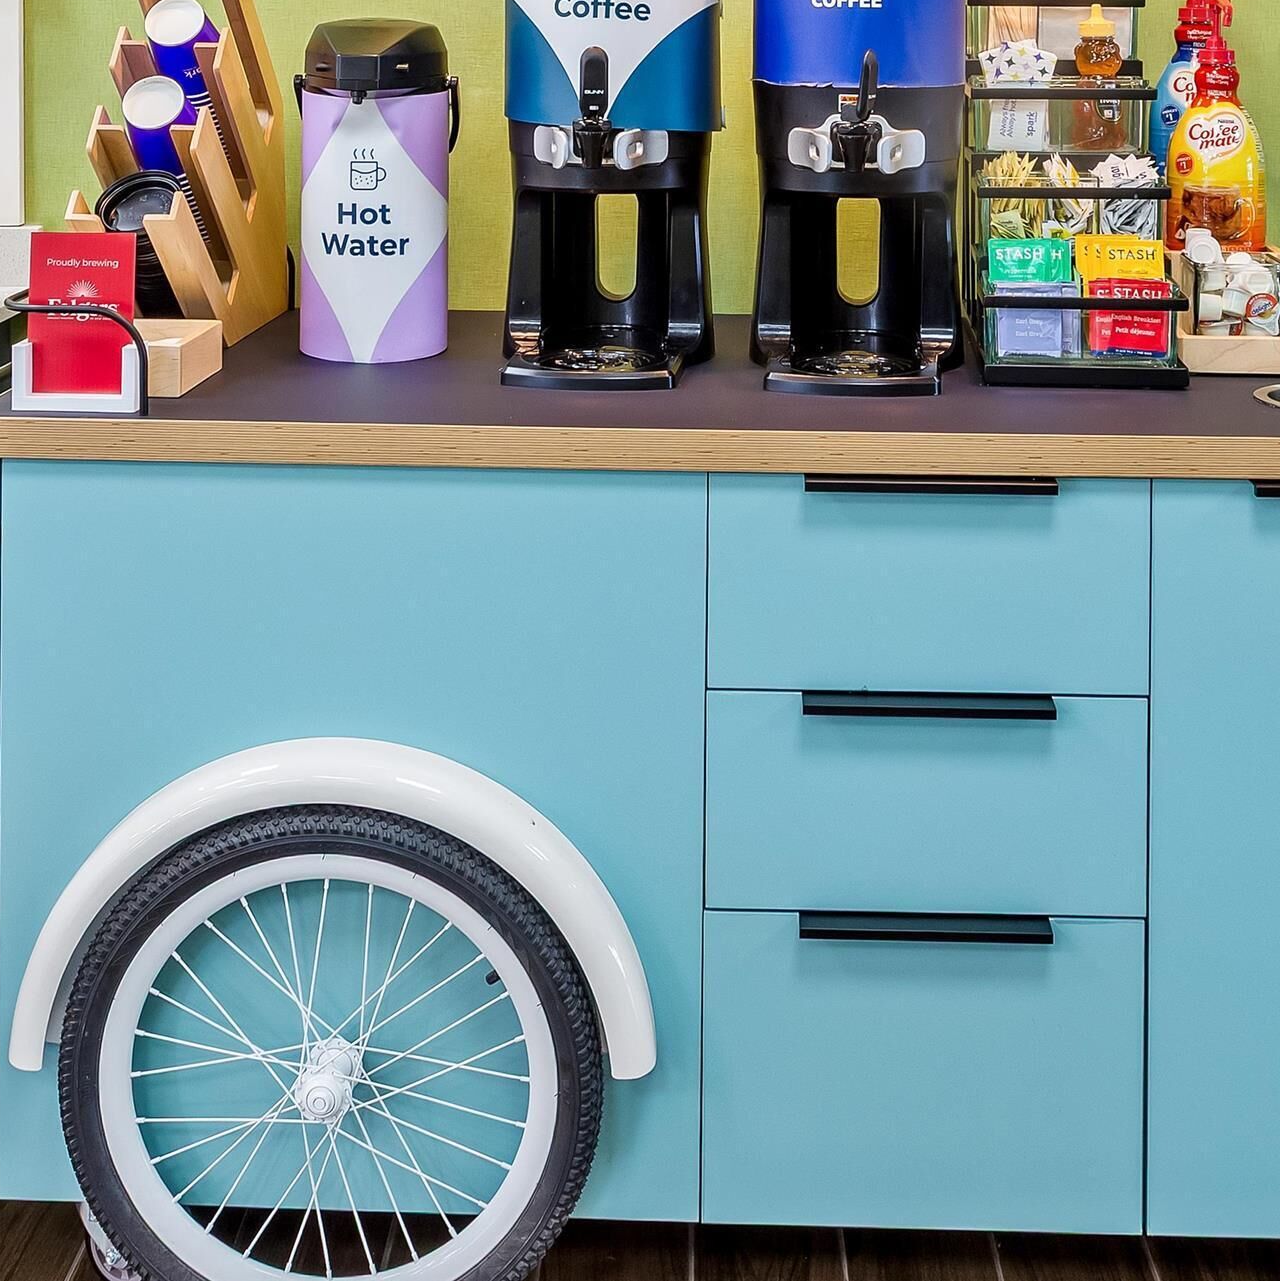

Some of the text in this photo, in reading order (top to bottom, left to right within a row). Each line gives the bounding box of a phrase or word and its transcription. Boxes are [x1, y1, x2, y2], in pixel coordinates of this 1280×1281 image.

[1026, 111, 1036, 137] spark
[1200, 135, 1239, 150] mate
[338, 203, 391, 224] Hot
[321, 233, 410, 256] Water
[996, 248, 1043, 260] STASH
[1108, 249, 1156, 260] STASH
[47, 258, 119, 269] Proudly brewing
[1113, 287, 1162, 299] STASH
